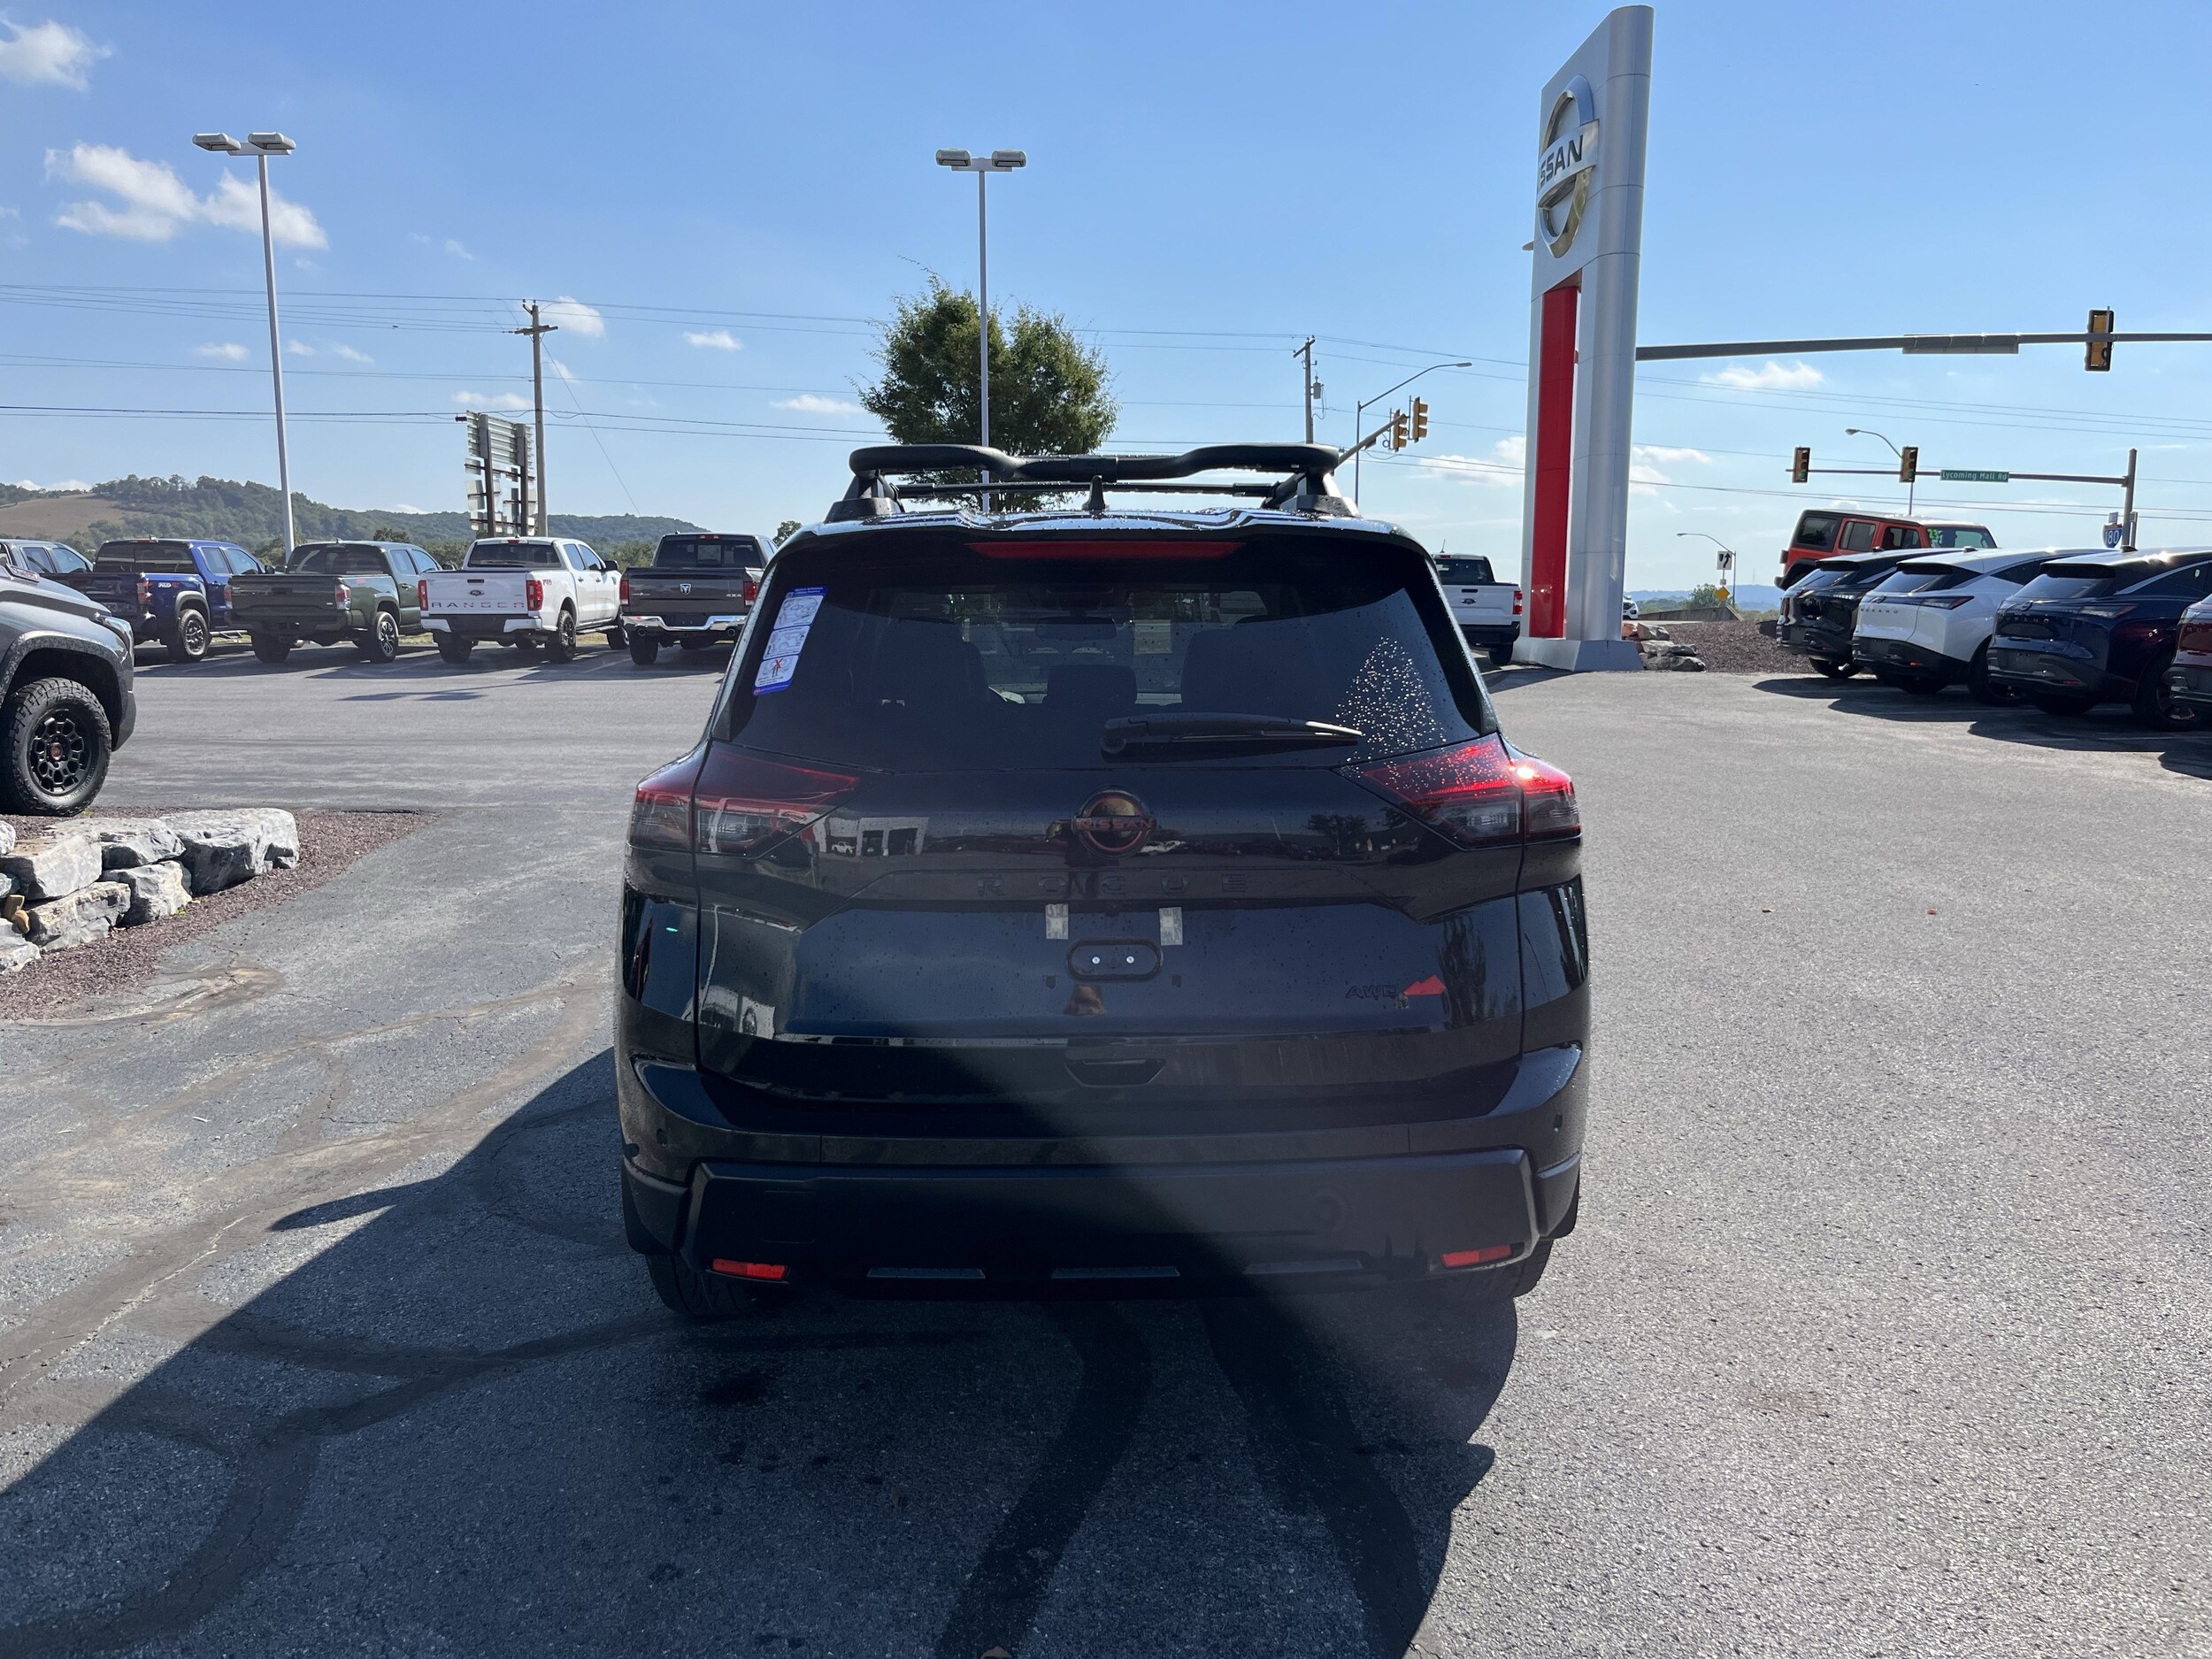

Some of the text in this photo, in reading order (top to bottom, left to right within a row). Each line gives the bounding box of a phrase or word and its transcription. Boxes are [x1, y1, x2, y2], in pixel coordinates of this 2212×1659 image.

[1540, 134, 1584, 188] SSAN
[1941, 471, 2008, 481] Lycoming Mall Rd
[2106, 530, 2120, 544] 180
[1075, 819, 1152, 830] NISSAN
[977, 873, 1248, 896] ROGUE
